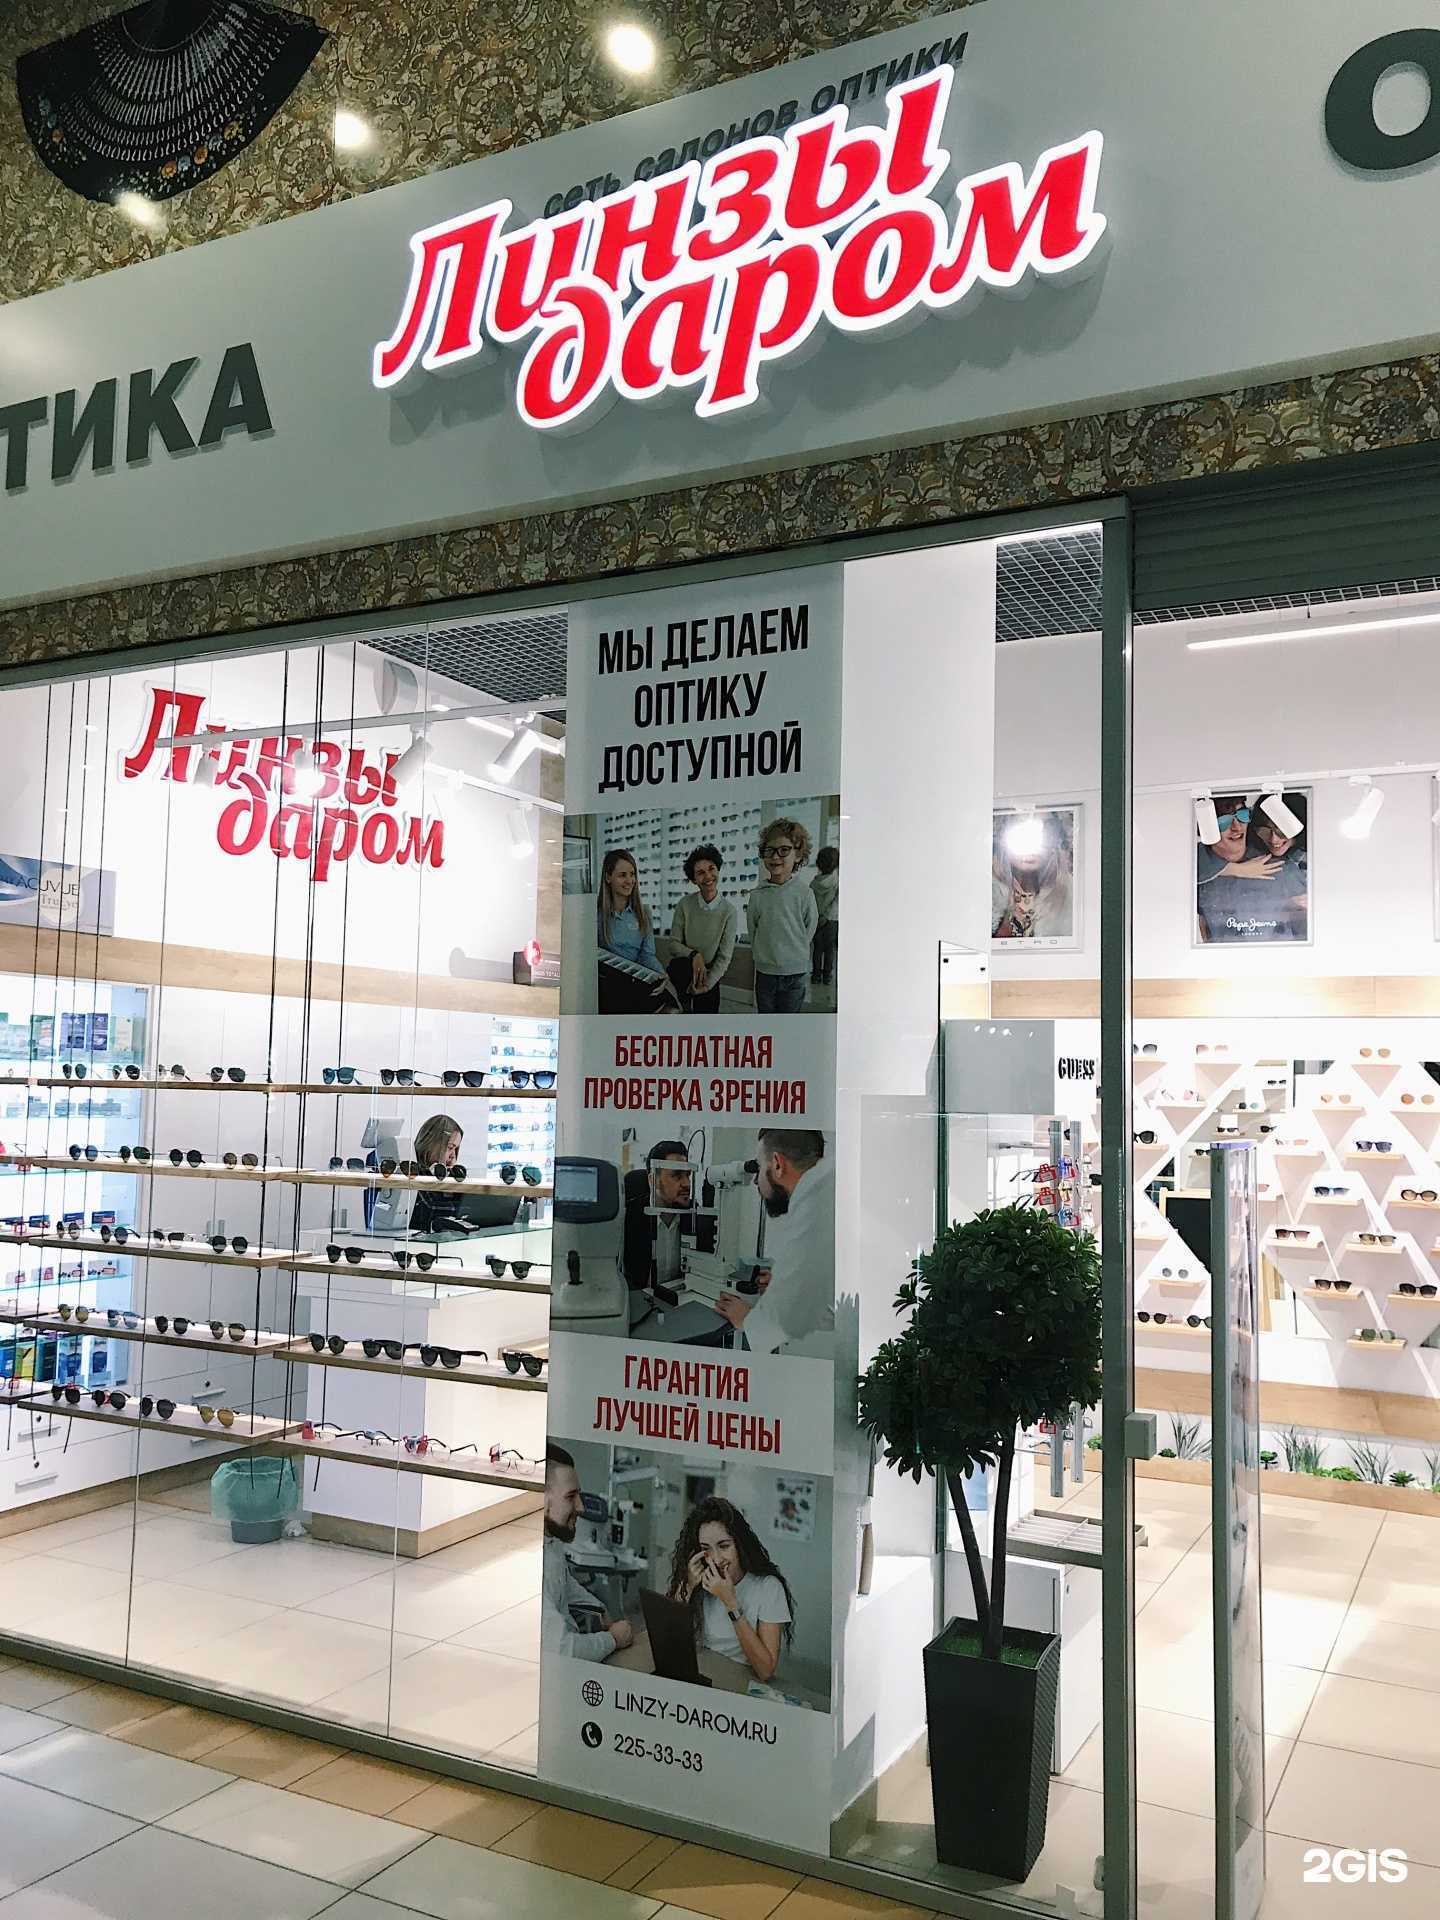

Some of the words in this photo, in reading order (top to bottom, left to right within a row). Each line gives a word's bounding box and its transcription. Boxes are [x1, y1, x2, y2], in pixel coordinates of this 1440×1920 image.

[373, 66, 953, 388] Линзы
[517, 132, 1106, 429] даром
[0, 342, 273, 490] ТИКА
[598, 626, 653, 675] МЫ
[661, 604, 809, 672] ДЕЛАЕМ
[634, 670, 767, 728] ОПТИКУ
[598, 720, 802, 794] ДОСТУПНОЙ
[216, 772, 445, 882] даром
[615, 1035, 773, 1068] БЕСПЛАТНАЯ
[1058, 1057, 1095, 1080] GUESS
[584, 1077, 703, 1112] ПРОВЕРКА
[709, 1078, 806, 1114] ЗРЕНИЯ
[624, 1355, 749, 1402] ГАРАНТИЯ
[593, 1396, 699, 1443] ЛУЧШЕЙ
[707, 1410, 780, 1454] ЦЕНЫ
[615, 1690, 777, 1744] LINZY-DAROM.RU
[614, 1733, 703, 1772] 225-33-33
